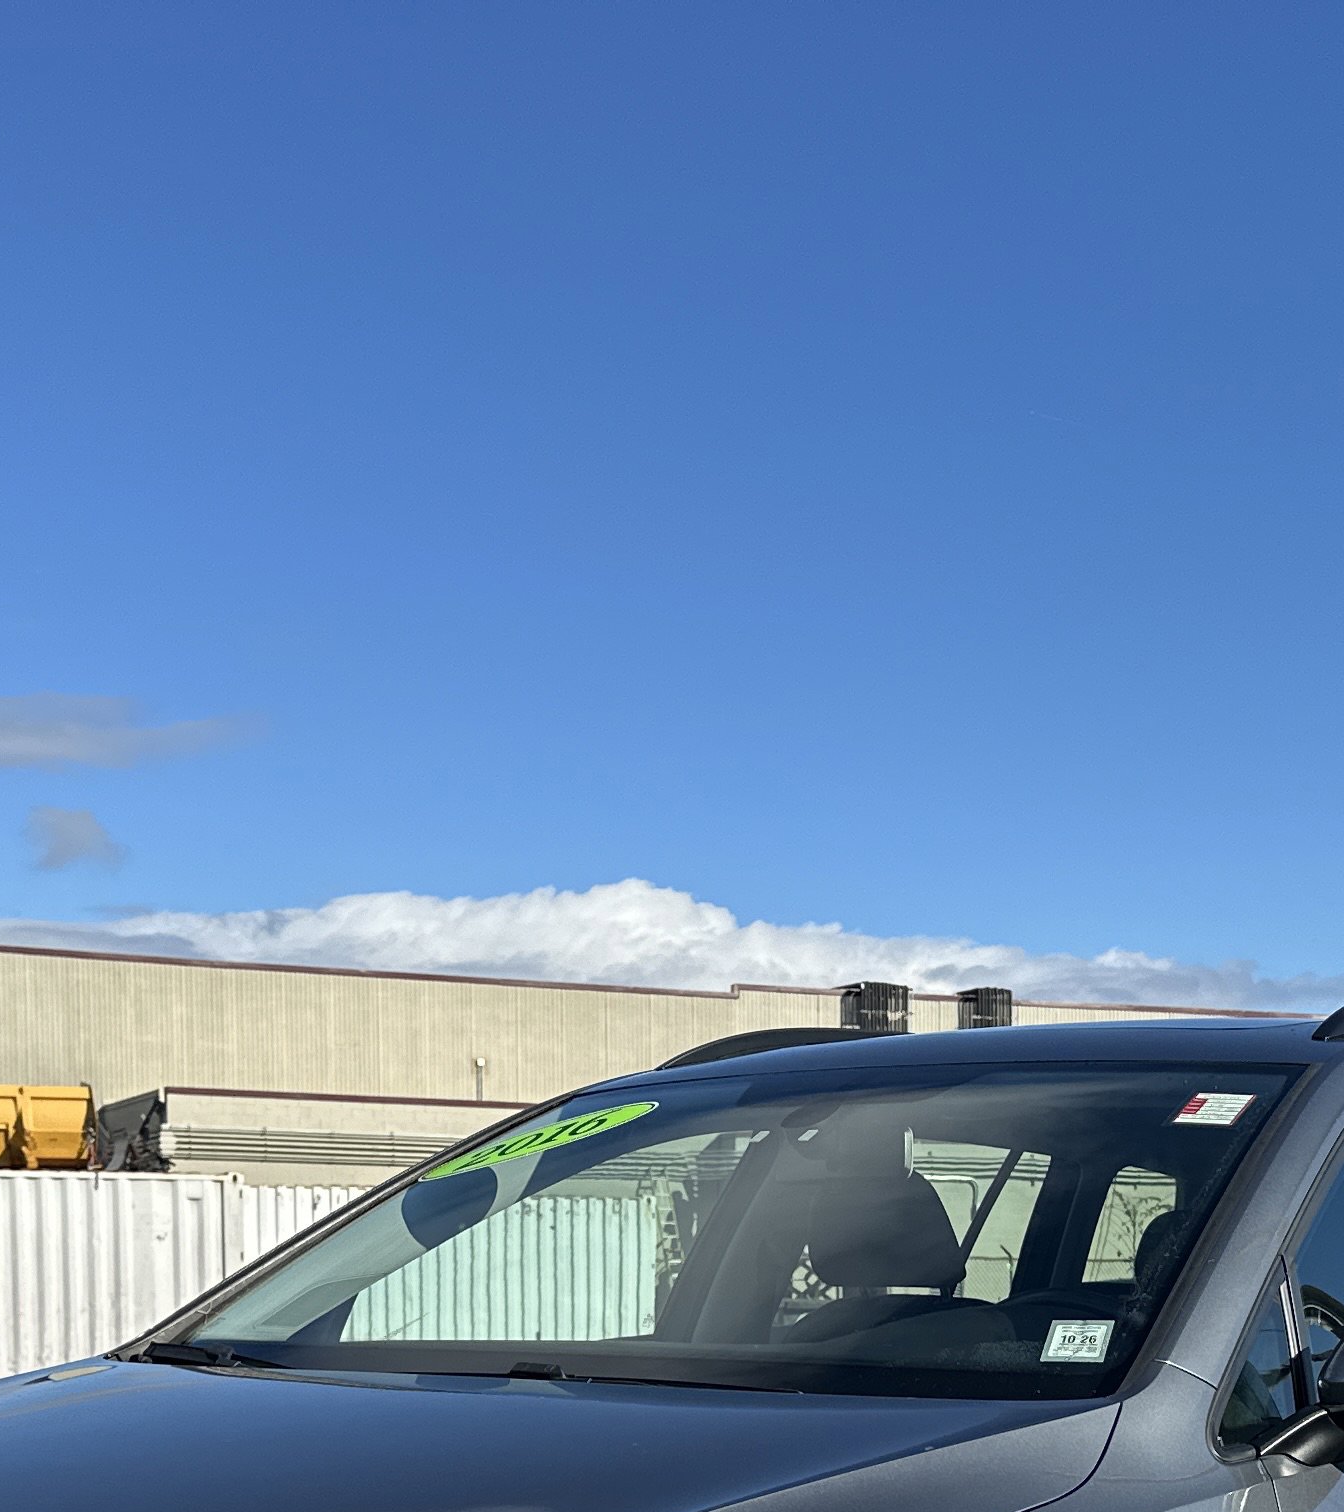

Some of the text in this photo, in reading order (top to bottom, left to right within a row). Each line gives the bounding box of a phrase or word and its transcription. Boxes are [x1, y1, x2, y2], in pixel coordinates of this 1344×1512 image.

[455, 1109, 622, 1172] 2016
[1061, 1335, 1097, 1344] 10 26
